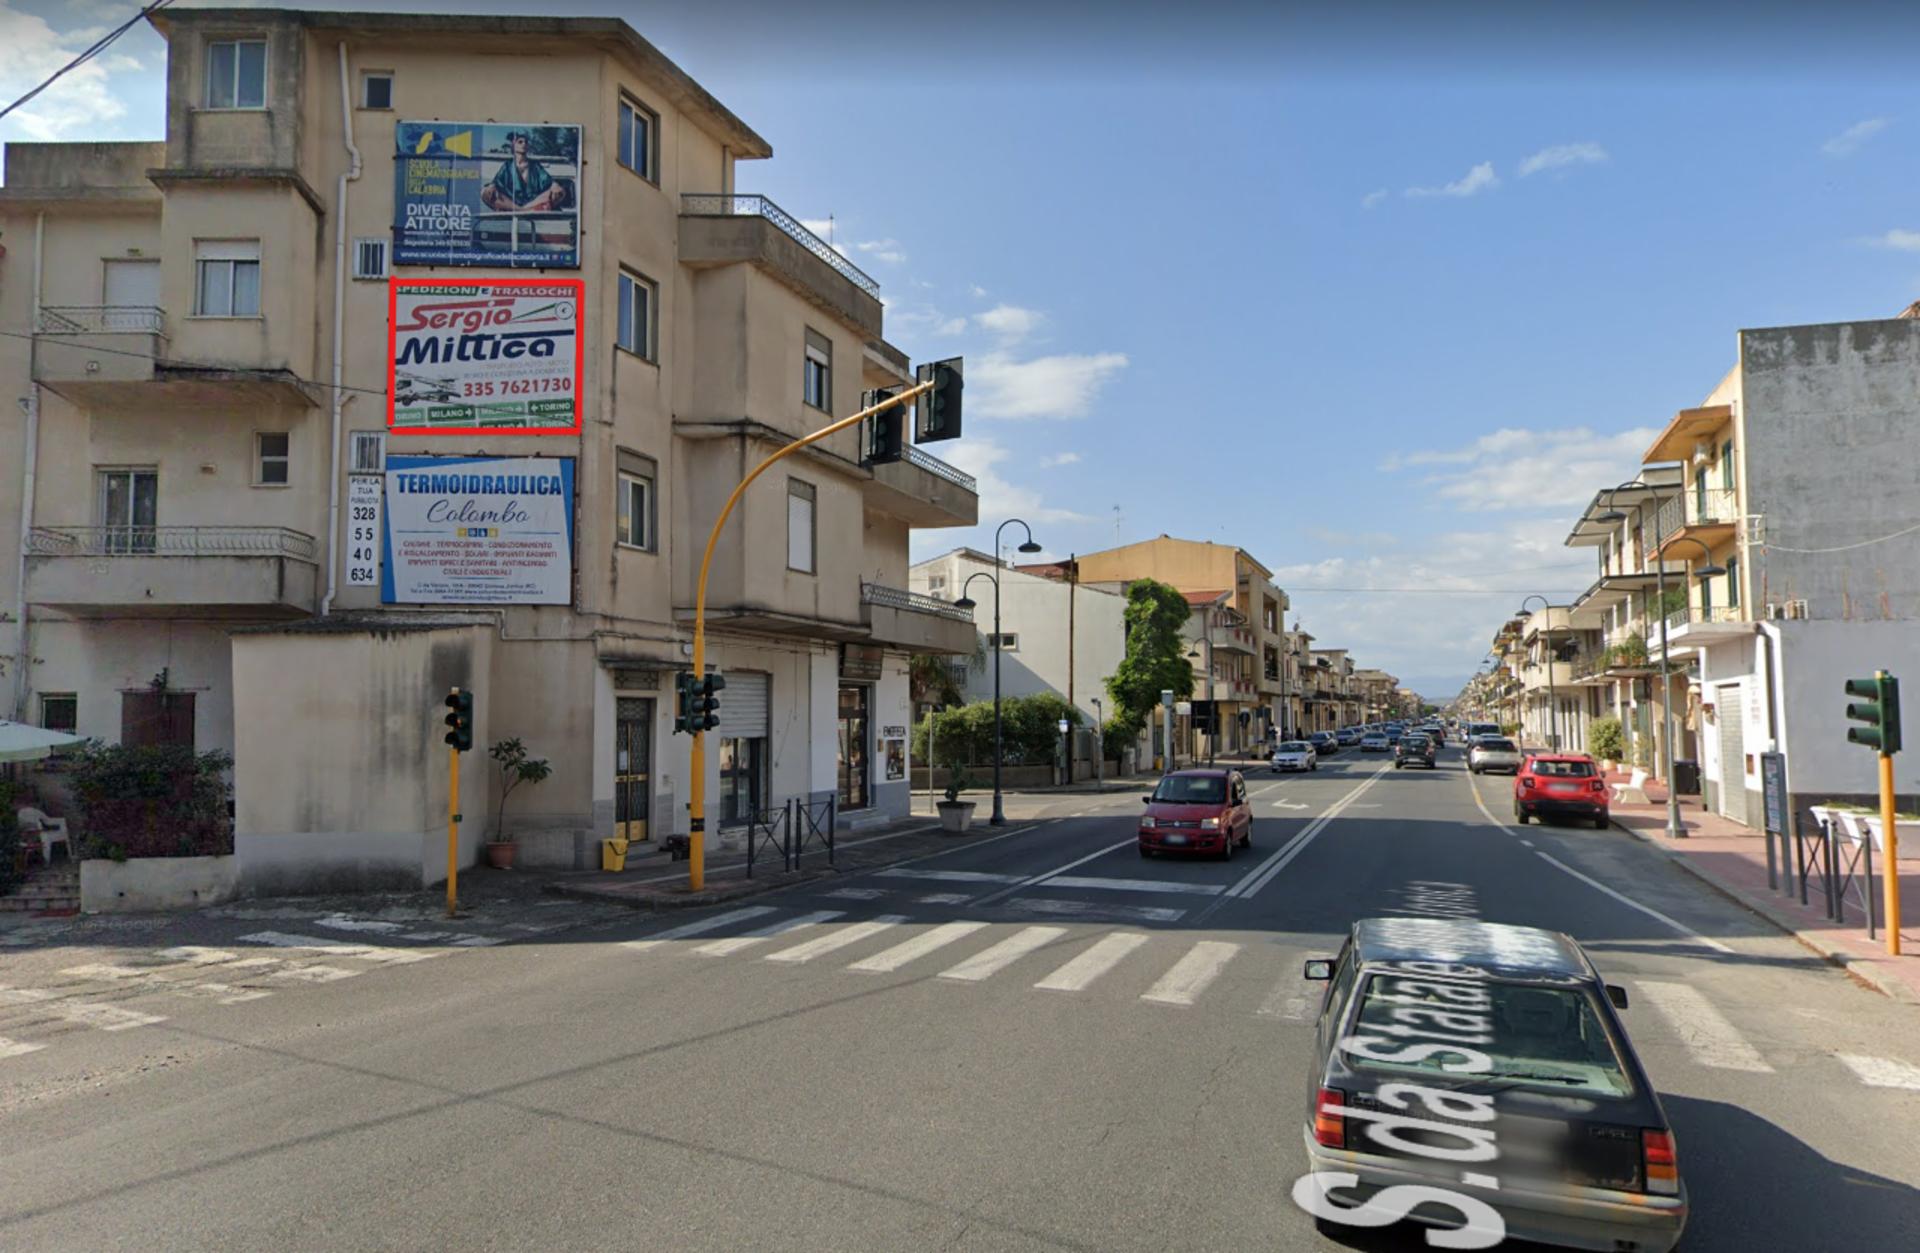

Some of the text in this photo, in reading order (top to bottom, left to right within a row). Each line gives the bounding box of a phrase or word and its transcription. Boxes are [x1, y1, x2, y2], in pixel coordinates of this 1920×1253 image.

[406, 203, 472, 216] DIVENTA
[404, 216, 471, 230] ATTORE
[494, 286, 573, 297] TRASLOCHI
[397, 299, 515, 334] Sergio
[396, 330, 575, 366] Mittica
[464, 377, 572, 397] 335 7621730
[430, 408, 464, 417] MILANO
[539, 402, 571, 412] TORINO
[351, 477, 381, 486] PER LA
[396, 474, 562, 495] TERMOIDRAULICA
[358, 486, 373, 495] TUA
[353, 507, 376, 520] 328
[351, 568, 374, 581] 634
